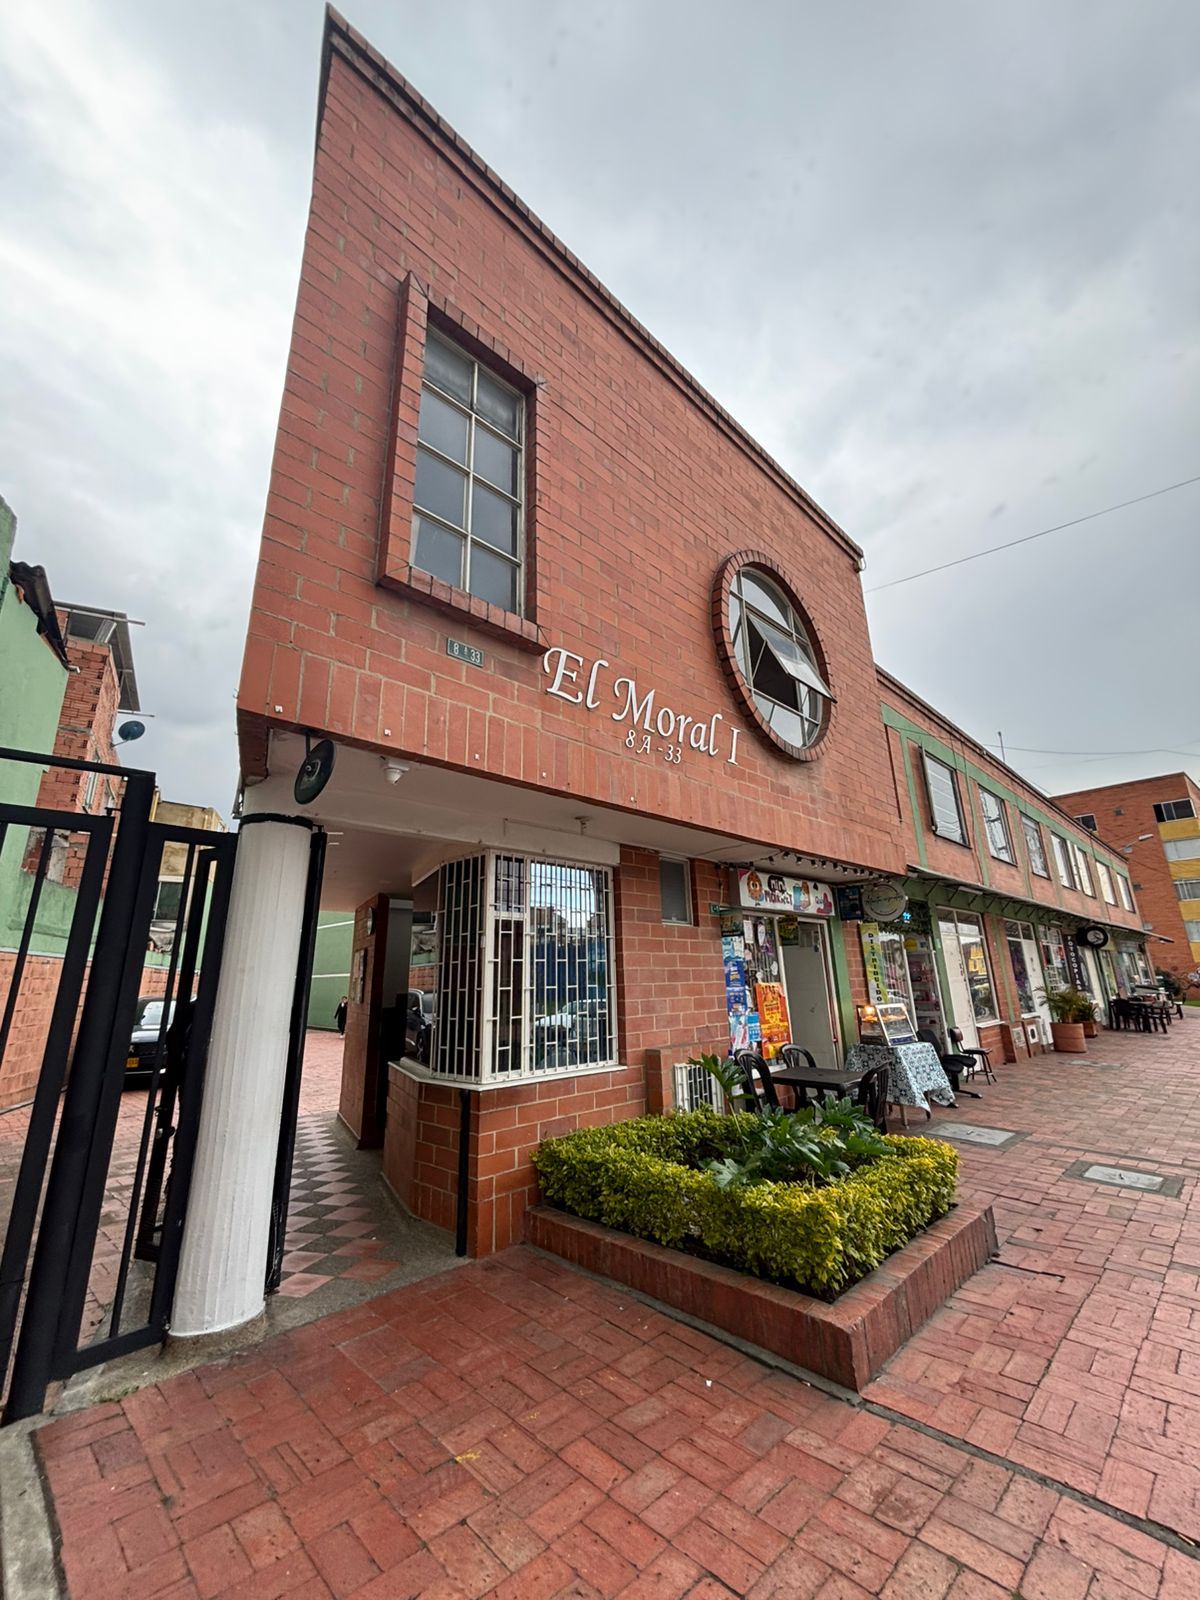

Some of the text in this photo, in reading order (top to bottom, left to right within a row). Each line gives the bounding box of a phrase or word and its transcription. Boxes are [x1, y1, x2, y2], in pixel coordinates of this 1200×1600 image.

[453, 642, 460, 656] 8
[470, 649, 481, 664] 33
[543, 647, 741, 765] El Moral I
[867, 932, 883, 1004] DISTRIBUIDO
[1067, 935, 1082, 990] FOTOCOPIAS
